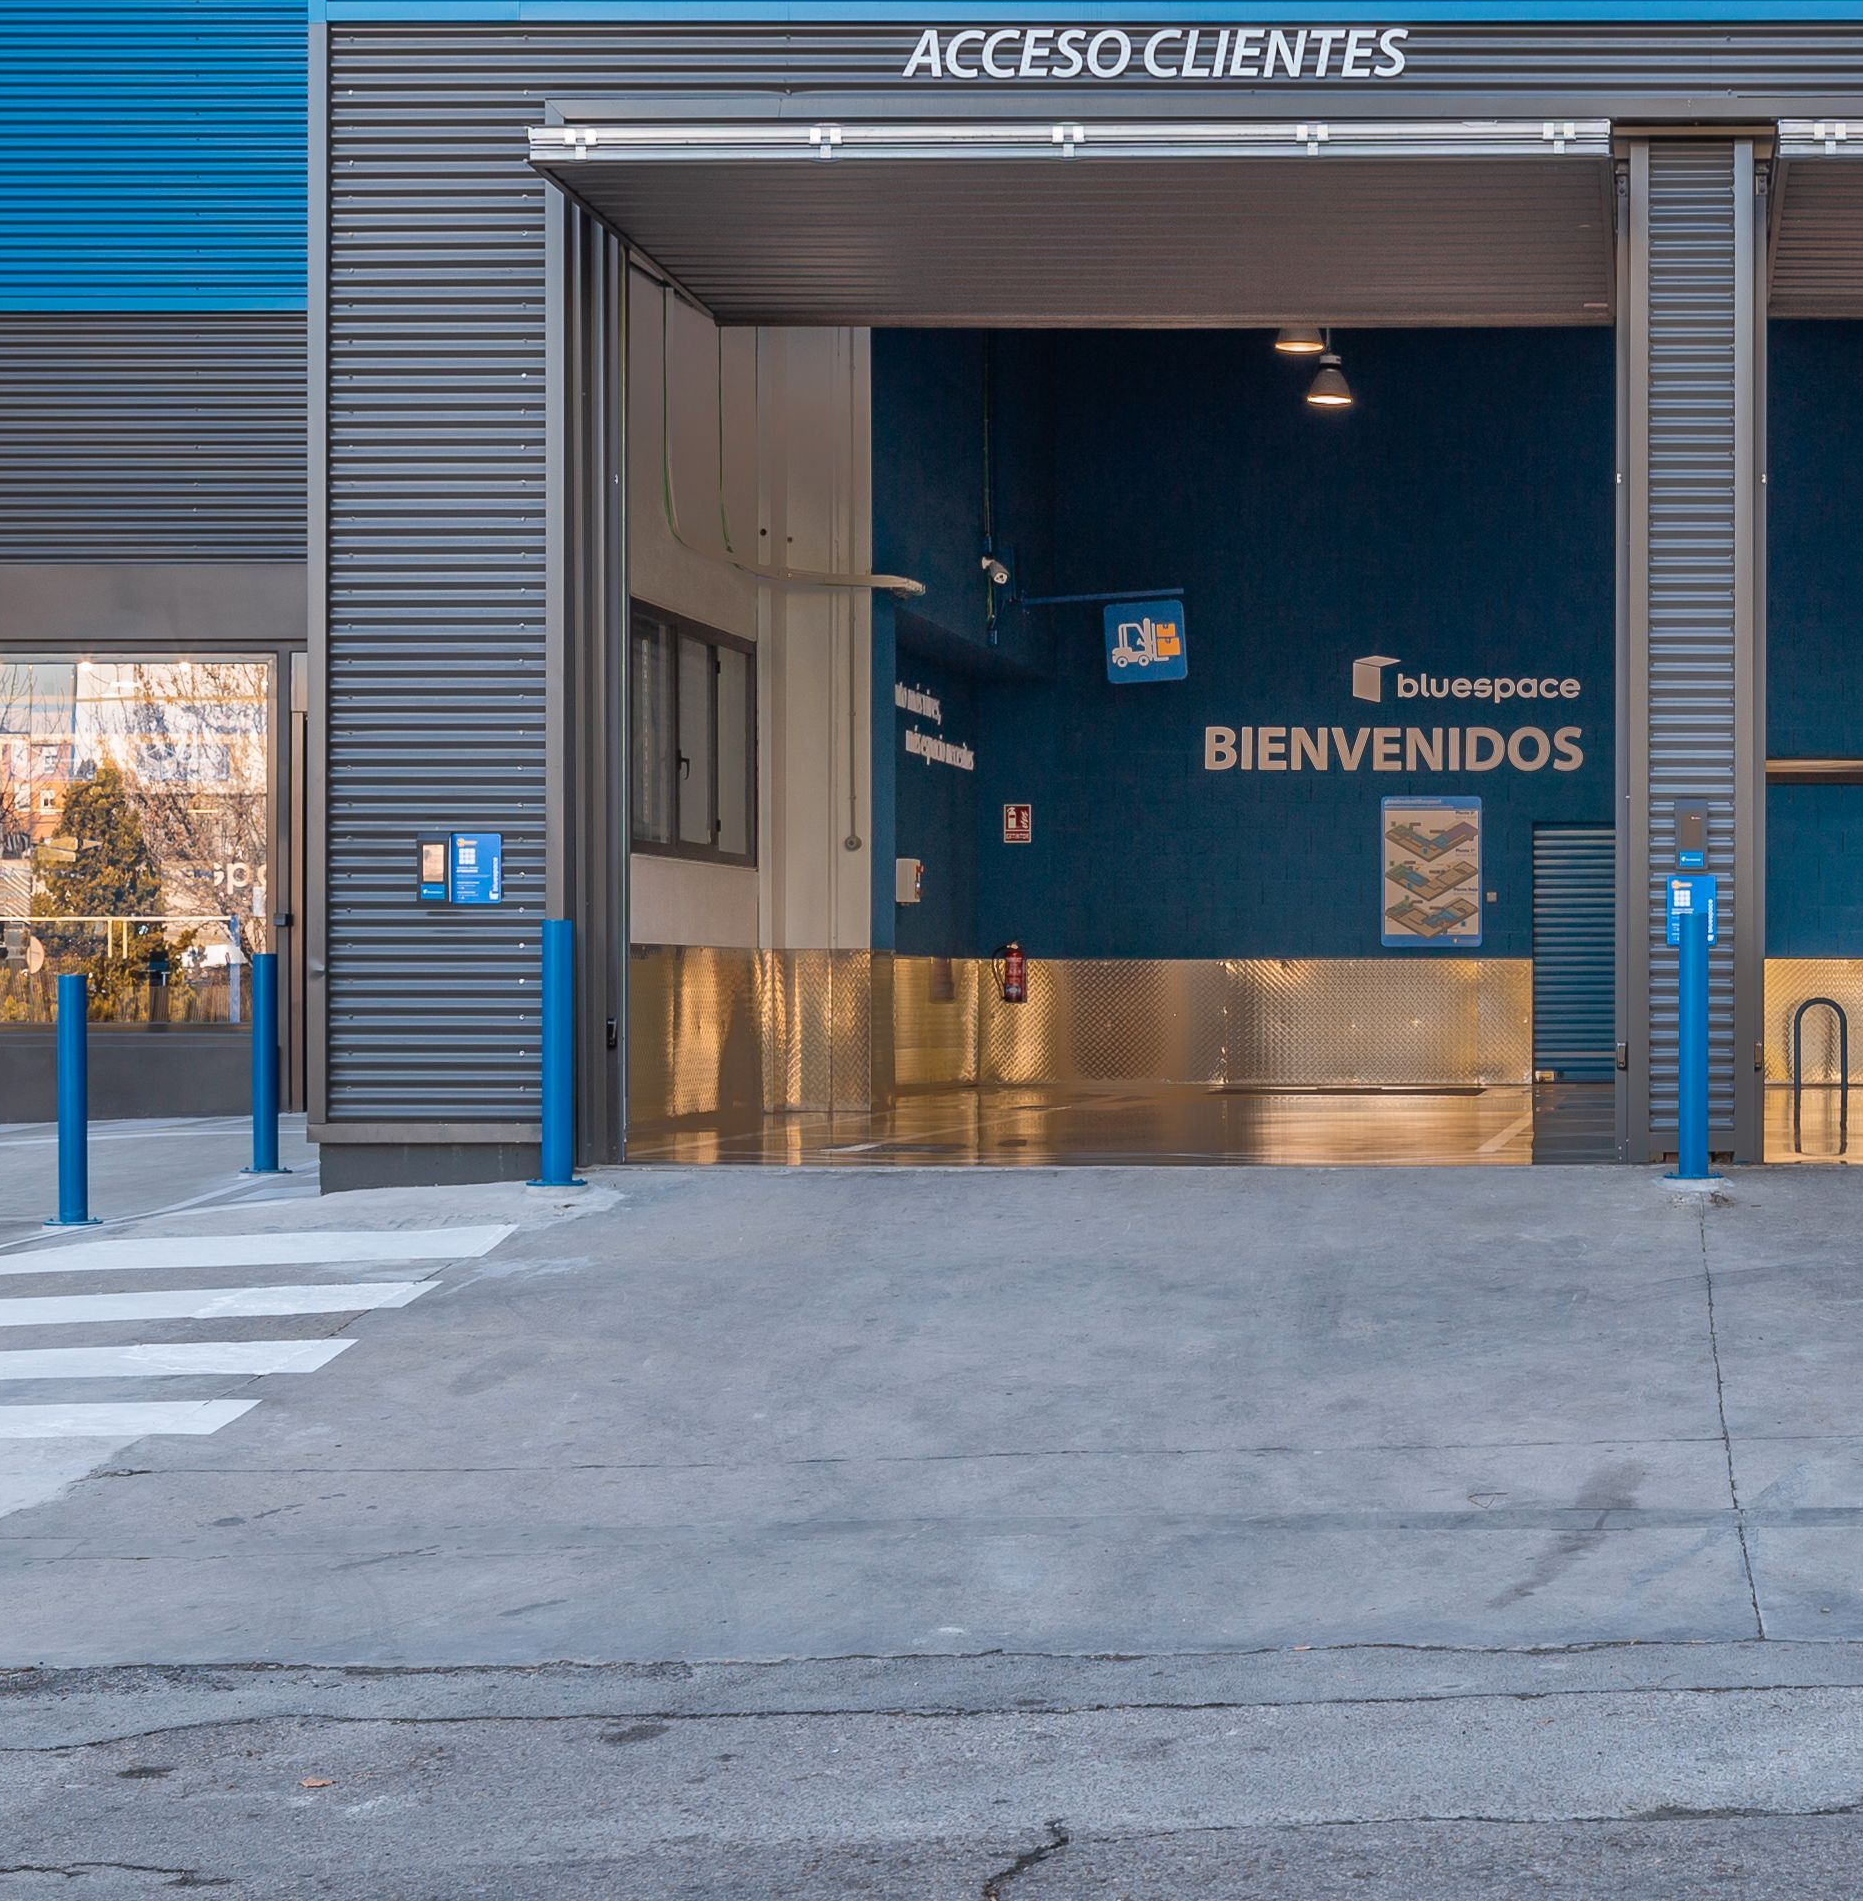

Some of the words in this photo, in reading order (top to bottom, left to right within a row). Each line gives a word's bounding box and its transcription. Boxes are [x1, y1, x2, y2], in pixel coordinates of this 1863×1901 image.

[902, 29, 1132, 79] ACCESO
[1143, 28, 1409, 78] CLIENTES
[1397, 673, 1581, 704] bluespace
[1204, 726, 1584, 772] BIENVENIDOS
